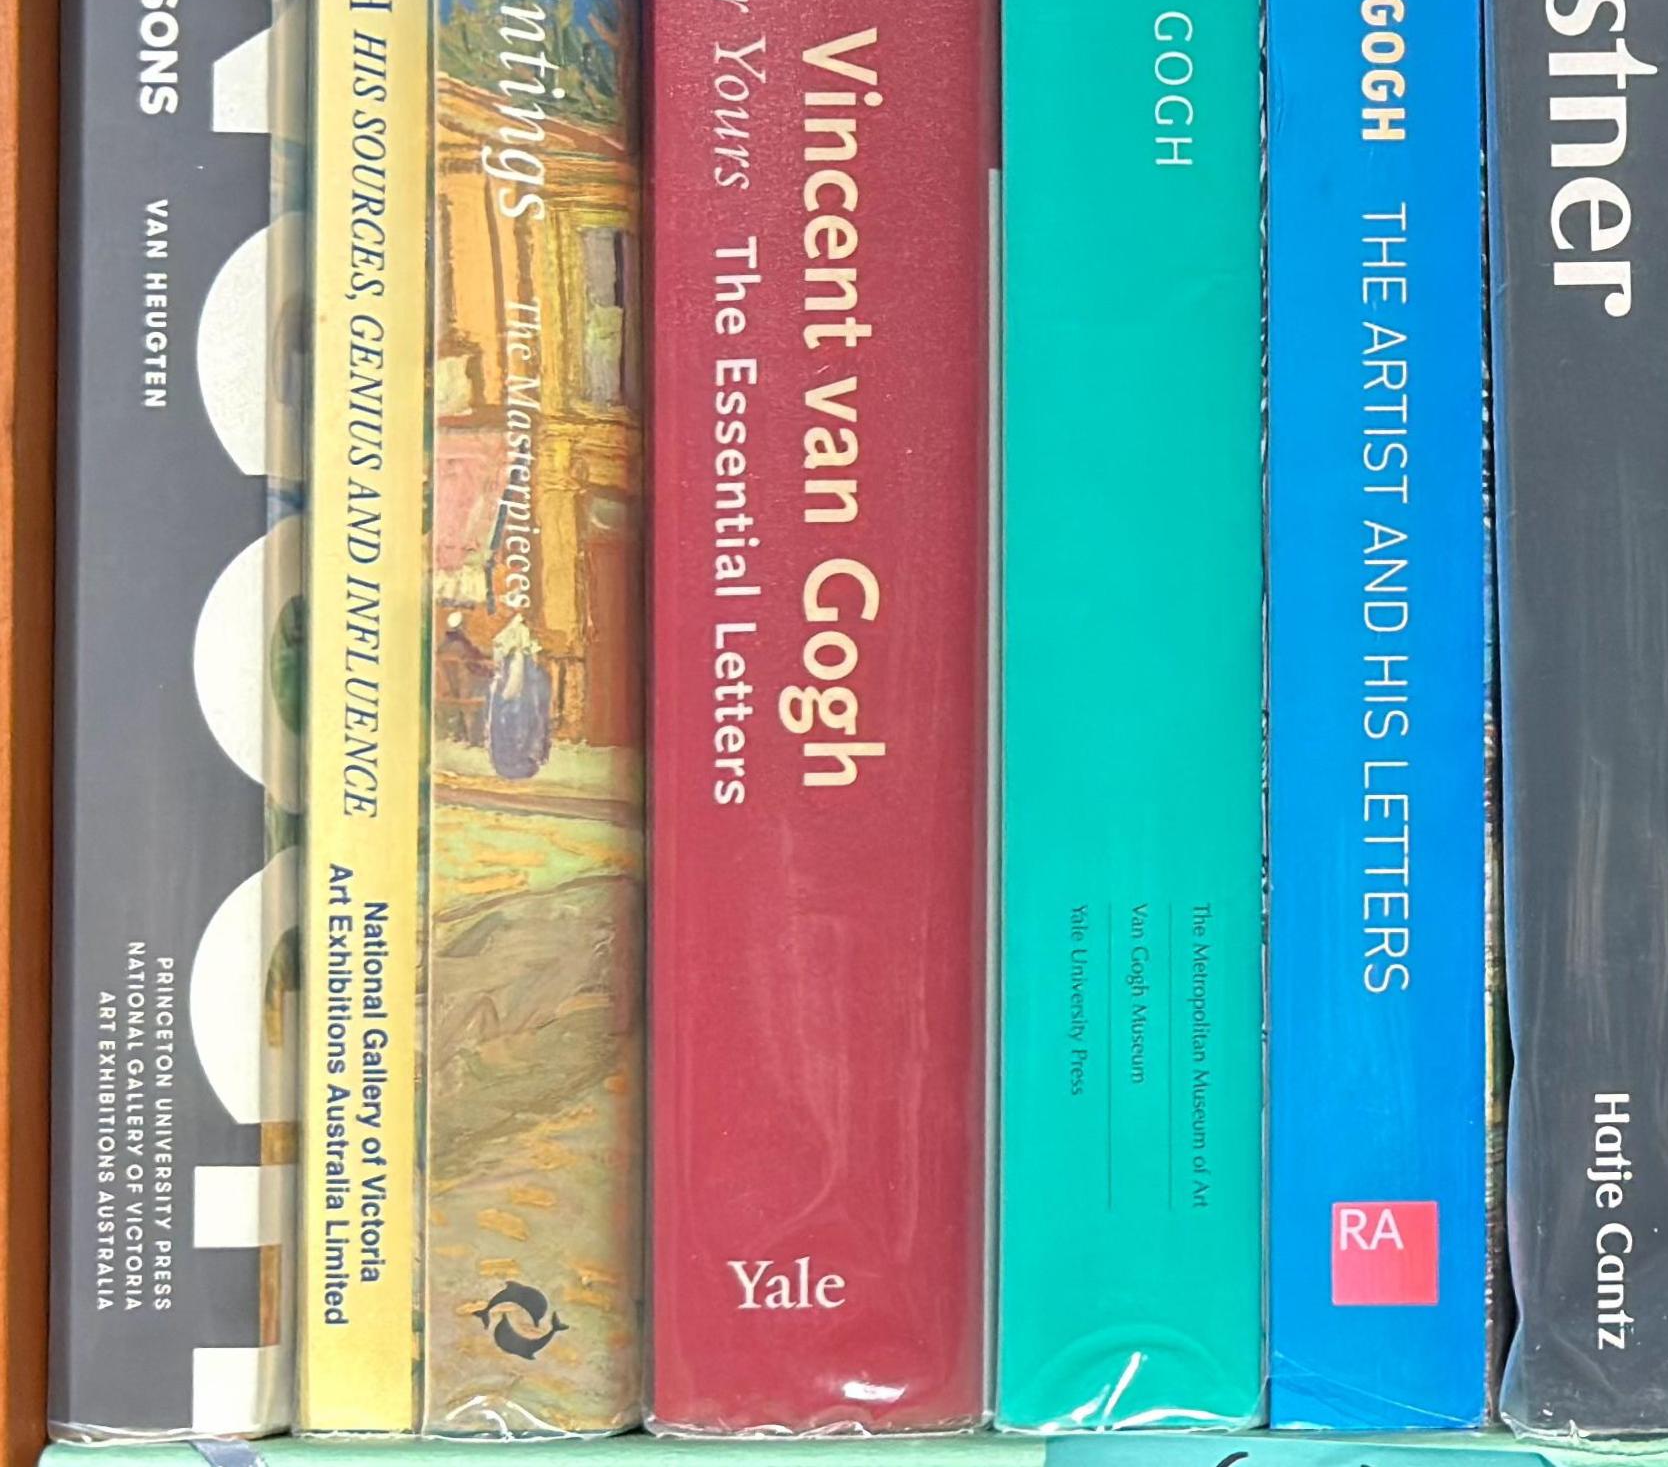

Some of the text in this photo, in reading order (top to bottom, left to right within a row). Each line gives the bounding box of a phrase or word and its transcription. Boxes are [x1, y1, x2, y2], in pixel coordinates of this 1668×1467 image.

[352, 30, 388, 103] HIS
[711, 34, 766, 190] Yours
[1153, 10, 1195, 167] GOGH
[142, 199, 168, 409] VAN HEUGTEN
[344, 109, 388, 302] SOURCES,
[347, 313, 385, 470] GENIUS
[497, 295, 541, 609] The Masterpieces
[777, 27, 887, 788] Vincent van Gogh
[347, 480, 382, 567] AND
[712, 235, 762, 806] The Essential Letters
[1361, 201, 1410, 994] THE ARTIST AND HIS LETTERS
[342, 574, 381, 820] INFLUENCE
[323, 863, 353, 1326] Art Exhibitions Australia Limited
[355, 900, 390, 1283] National Gallery of Victoria
[1066, 904, 1089, 1096] Yale University Press
[1127, 903, 1150, 1084] Van Gogh Museum
[1187, 903, 1211, 1209] The Metropolitan Museum of Art
[96, 991, 117, 1312] ART EXHIBITIONS AUSTRALIA
[123, 940, 146, 1312] NATIONAL GALLERY OF VICTORIA
[152, 956, 174, 1312] PRINCETON UNIVERSITY PRESS
[1339, 1209, 1404, 1251] RA
[1586, 1092, 1635, 1351] Hatje Cantz
[727, 1257, 847, 1313] Yale
